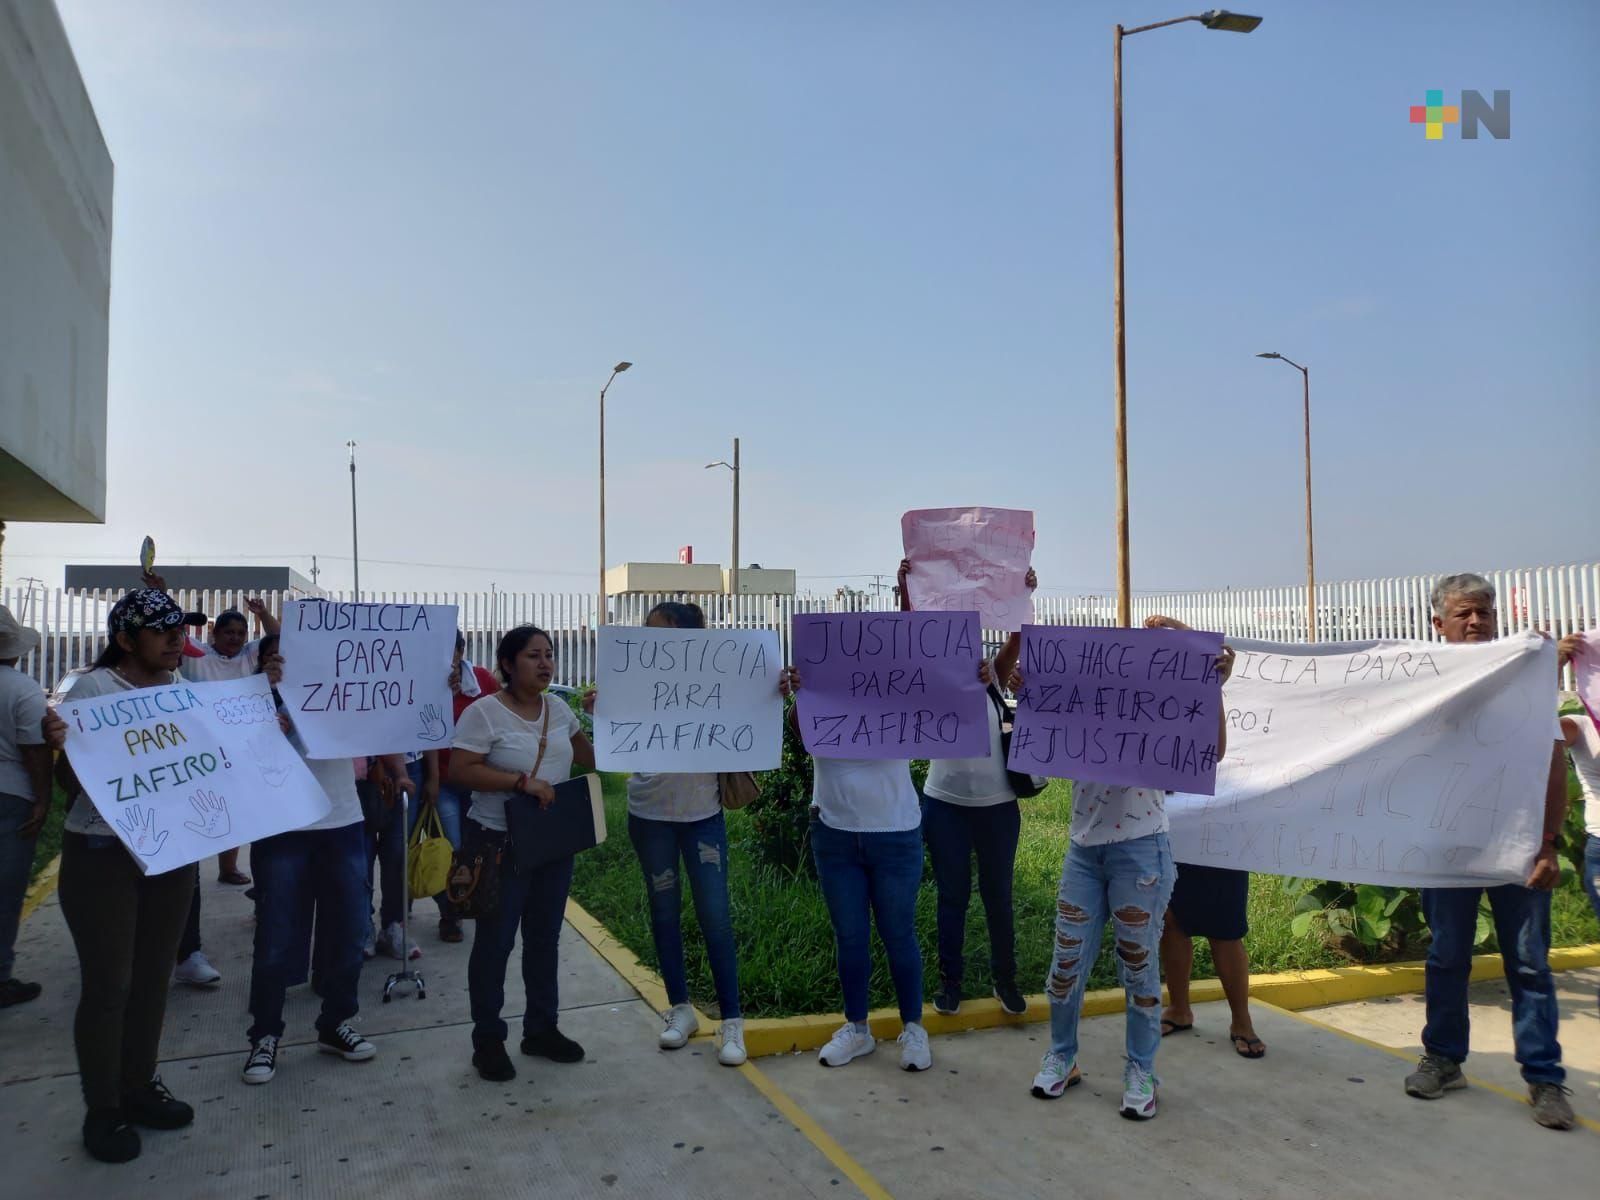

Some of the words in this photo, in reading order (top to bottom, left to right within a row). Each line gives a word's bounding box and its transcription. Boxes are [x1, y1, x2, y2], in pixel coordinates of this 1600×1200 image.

[298, 603, 429, 632] ¡JUSTICIA
[335, 638, 404, 677] PARA
[611, 639, 767, 679] JUSTICIA
[805, 618, 973, 665] JUSTICIA
[1026, 637, 1067, 675] NOS
[1076, 640, 1135, 679] HACE
[1147, 648, 1220, 685] FALTA
[1344, 651, 1440, 684] PARA
[301, 679, 415, 712] ZAFIRO!
[652, 681, 721, 711] PARA
[849, 667, 926, 697] PARA
[72, 688, 203, 732] ¡JUSTICIA
[124, 722, 187, 756] PARA
[610, 721, 754, 755] ZAFIRO
[813, 710, 960, 748] ZAFIRO
[107, 746, 232, 802] ZAFIRO!
